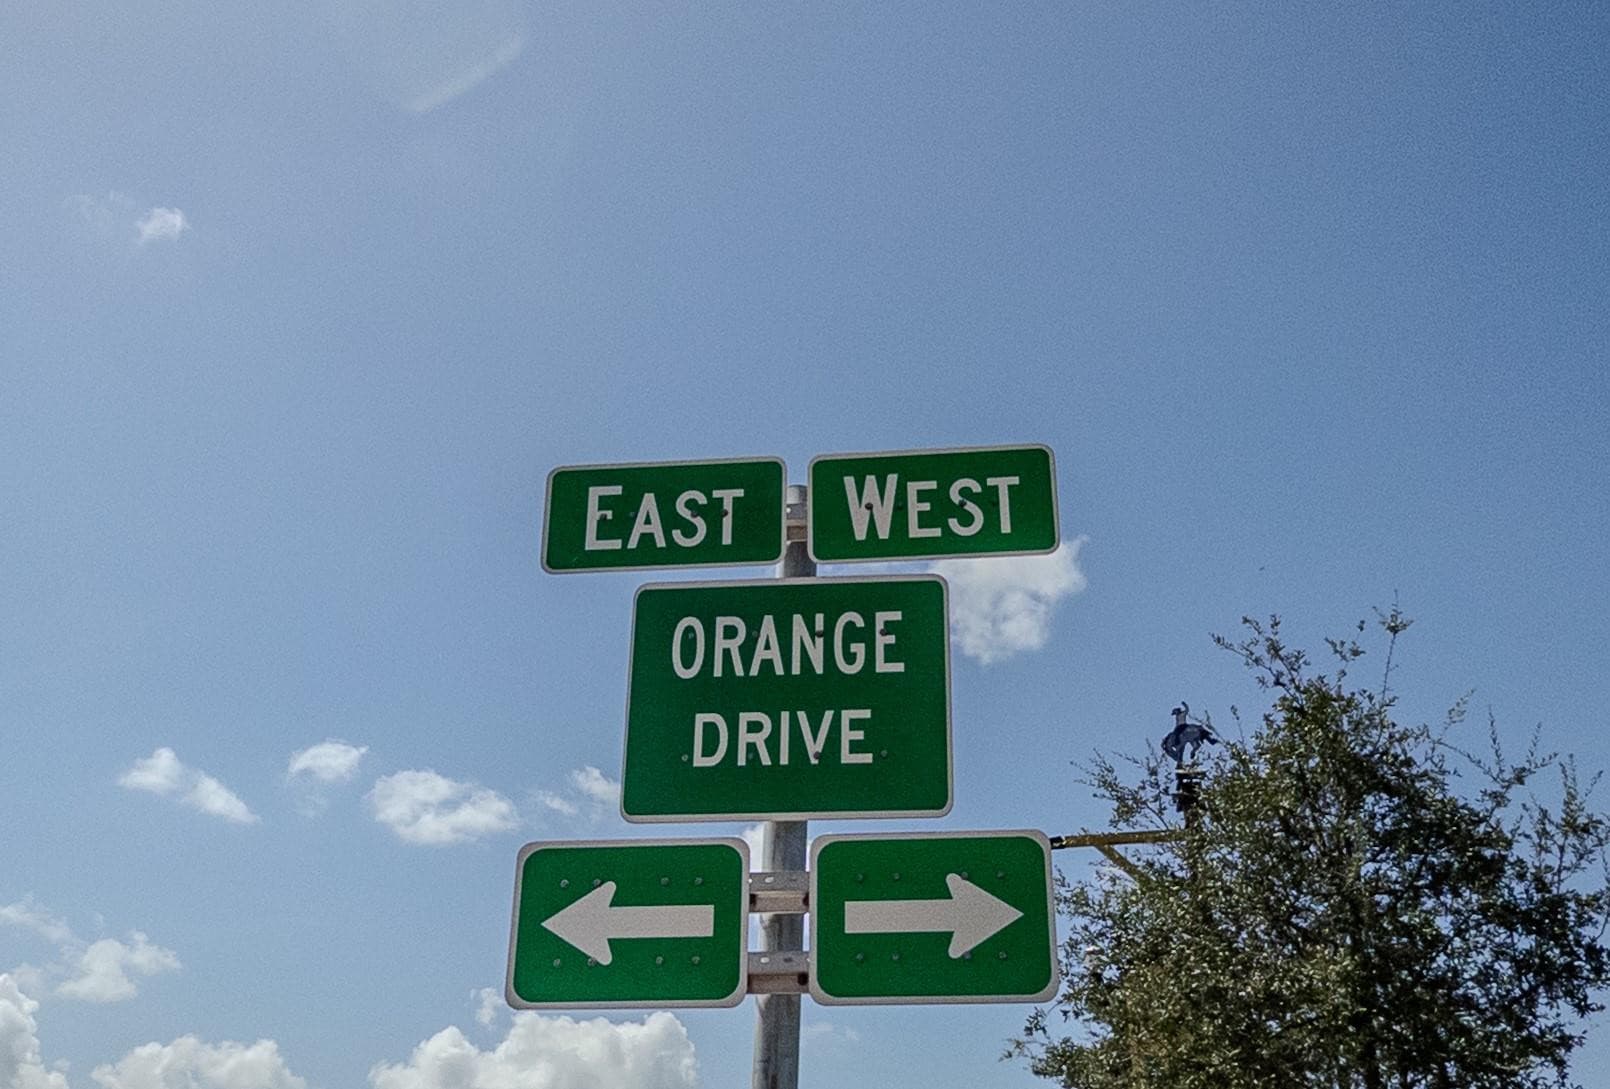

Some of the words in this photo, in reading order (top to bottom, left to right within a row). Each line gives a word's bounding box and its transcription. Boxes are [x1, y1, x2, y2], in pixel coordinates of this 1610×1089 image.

[584, 485, 744, 552] EAST
[843, 473, 1020, 541] WEST
[671, 610, 906, 680] ORANGE
[692, 708, 874, 768] DRIVE
